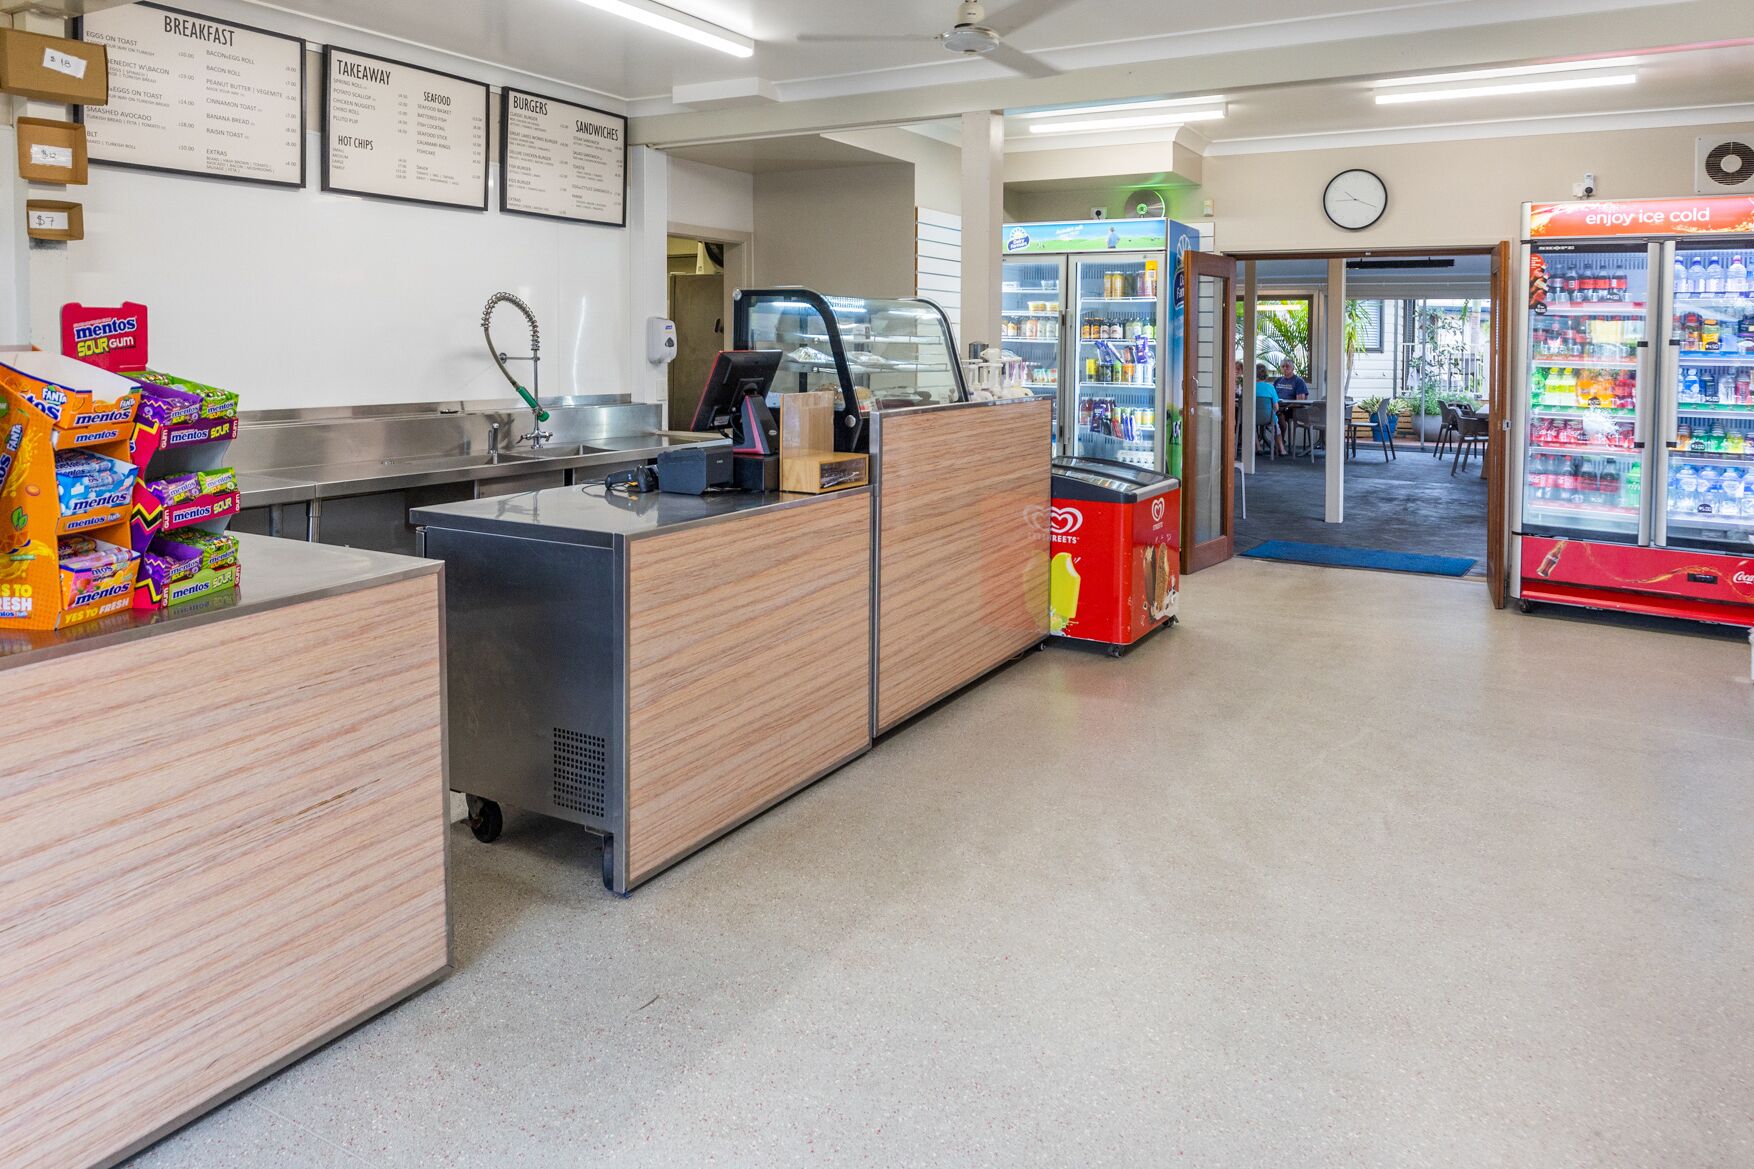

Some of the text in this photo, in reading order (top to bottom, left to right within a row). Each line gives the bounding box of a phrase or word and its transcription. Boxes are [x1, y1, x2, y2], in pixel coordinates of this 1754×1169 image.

[86, 30, 104, 40] EGGS
[105, 34, 116, 42] ON
[117, 36, 138, 46] TOAST
[164, 15, 236, 47] BREAKFAST
[60, 58, 72, 68] 18
[241, 56, 255, 64] ROLL
[206, 65, 240, 77] BACON ROLL
[336, 59, 391, 86] TAKEAWAY
[143, 90, 162, 100] TOAST
[206, 78, 228, 88] PEANUT
[230, 82, 251, 92] BUTTER
[256, 88, 283, 98] VEGEMITE
[333, 88, 352, 98] POTATO
[206, 97, 257, 112] CINNAMON TOAST
[332, 98, 376, 111] CHICKEN NUGGETS
[424, 91, 451, 106] SEAFOOD
[513, 95, 548, 116] BURGERS
[86, 106, 152, 122] SMASHED AVOCADO
[417, 103, 436, 112] SEAFOOD
[206, 112, 250, 126] BANANA BREAD
[86, 130, 98, 138] BLT
[206, 128, 244, 139] RAISIN TOAST
[576, 120, 618, 142] SANDWICHES
[338, 134, 374, 151] HOT CHIPS
[206, 148, 228, 157] EXTRAS
[36, 214, 54, 226] $7
[1586, 207, 1710, 226] enjoy ice cold
[75, 318, 136, 340] mentos
[77, 337, 110, 358] SOUR
[43, 388, 68, 404] FANTA
[171, 406, 199, 418] mentos
[208, 402, 234, 413] mentos
[75, 410, 131, 424] mentos
[7, 424, 23, 452] FANTA
[76, 430, 118, 442] mentos
[171, 423, 230, 442] mentos SOUR
[170, 482, 196, 496] mentos
[207, 475, 232, 488] mentos
[72, 492, 128, 510] mentos
[174, 498, 232, 522] mentos SOUR
[68, 516, 106, 528] mentos
[209, 550, 235, 564] mentos
[171, 559, 200, 574] mentos
[13, 584, 32, 598] TO
[172, 571, 232, 598] mentos SOUR
[75, 583, 130, 604] mentos
[64, 598, 130, 624] YES TO FRESH
